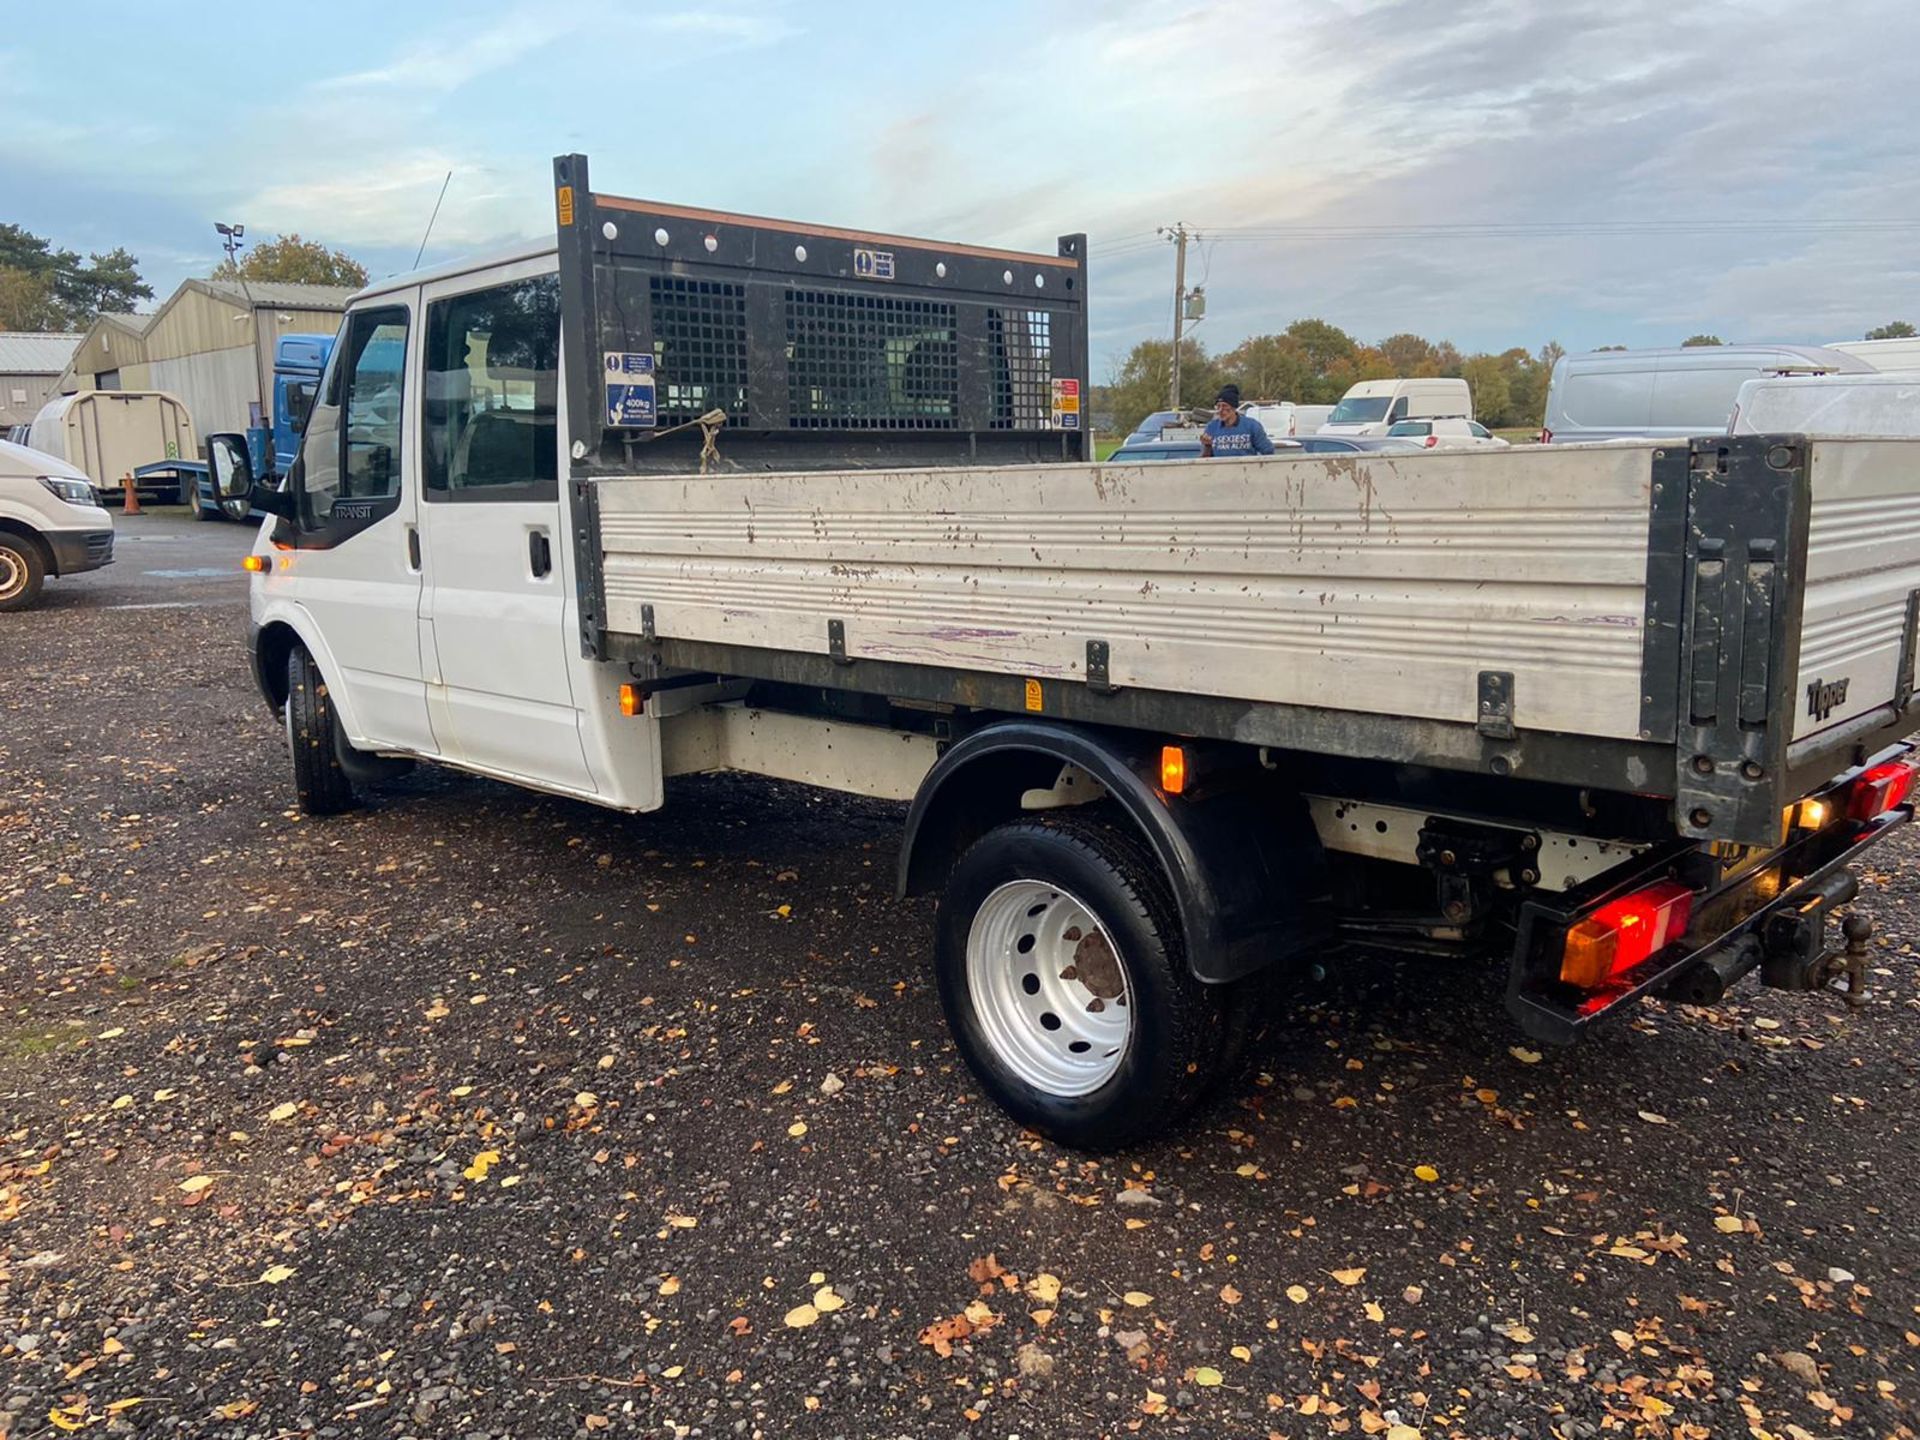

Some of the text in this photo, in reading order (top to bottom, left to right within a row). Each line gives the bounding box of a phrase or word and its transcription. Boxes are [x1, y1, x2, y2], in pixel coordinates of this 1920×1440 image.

[626, 399, 650, 409] 400kg
[335, 505, 372, 519] TRANSIT
[1806, 677, 1850, 722] Tipper
